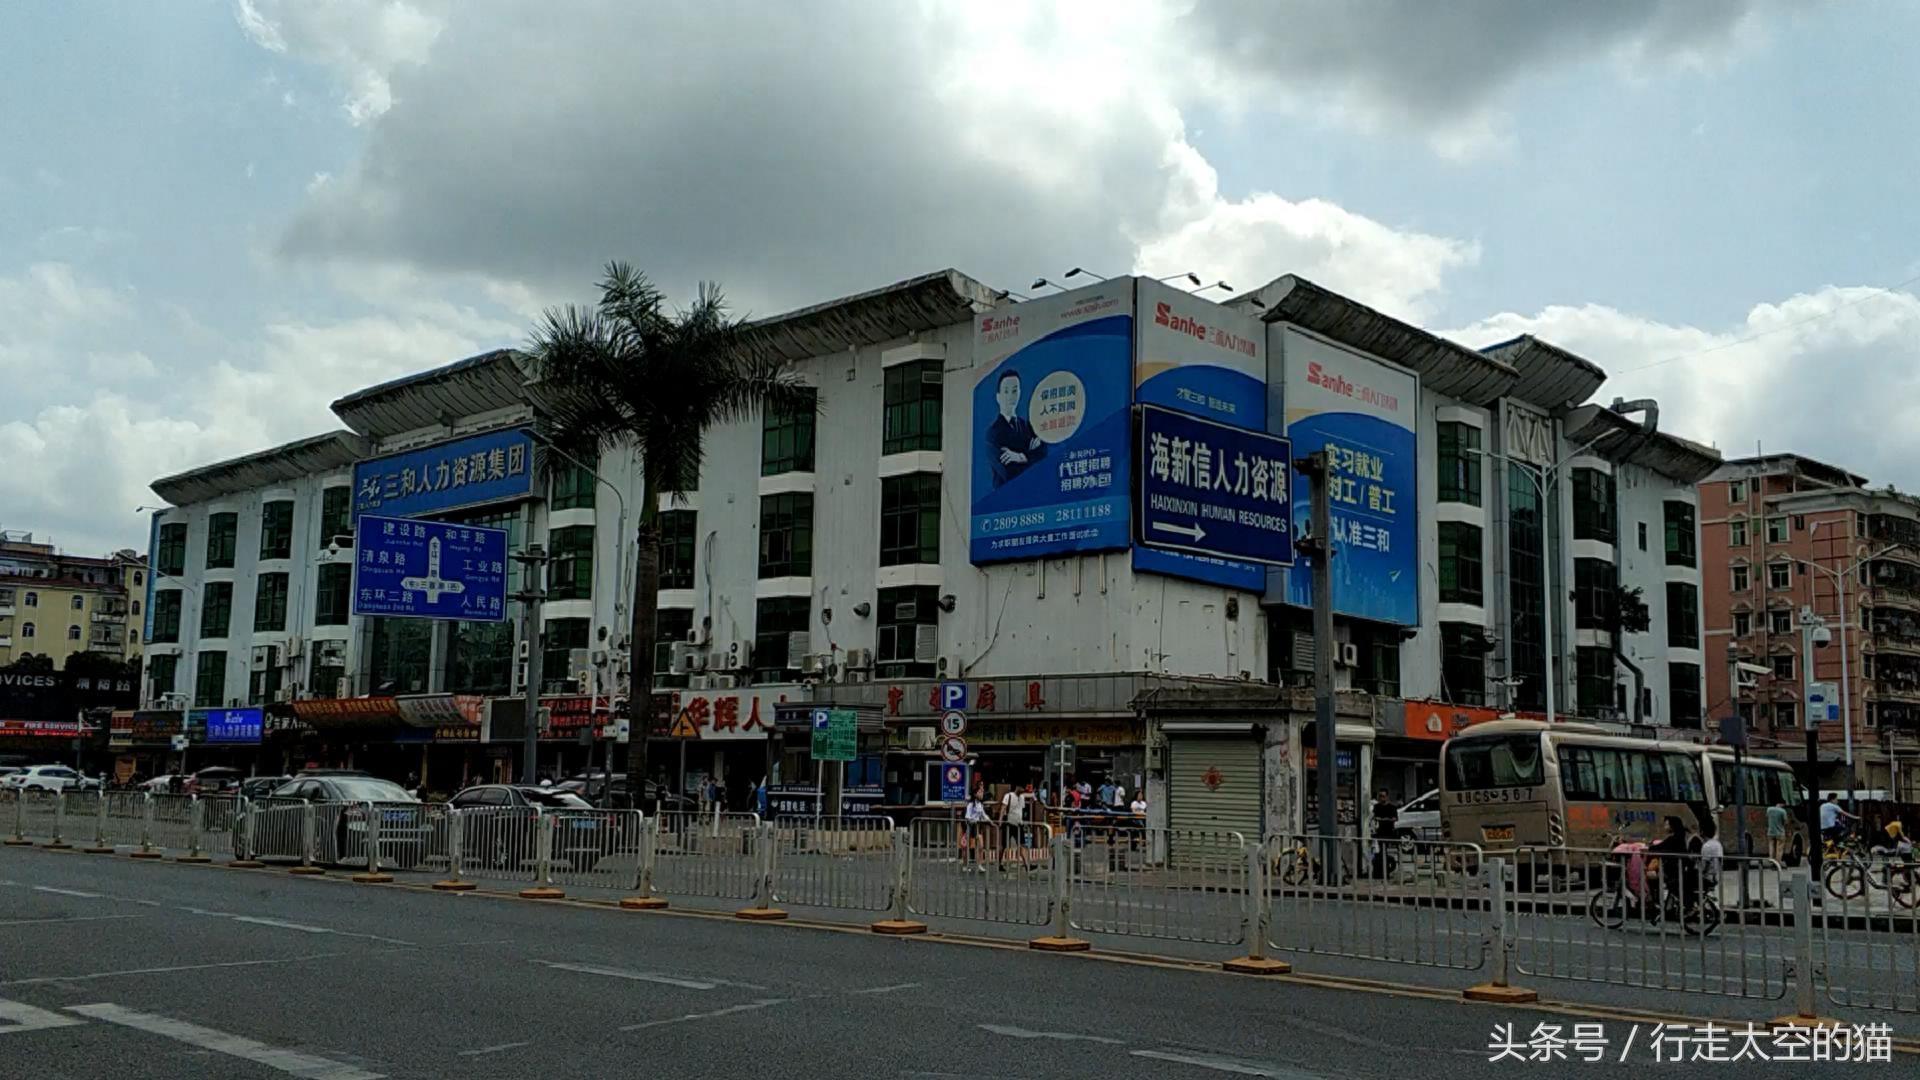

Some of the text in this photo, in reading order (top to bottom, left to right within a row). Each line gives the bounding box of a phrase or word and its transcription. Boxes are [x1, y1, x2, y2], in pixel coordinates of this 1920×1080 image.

[981, 315, 1021, 333] Sanhe
[1155, 301, 1206, 340] Sanhe
[1307, 361, 1353, 397] Sanhe
[383, 442, 526, 498] 三和人力资源集团
[1059, 456, 1111, 478] 代理招聘
[1150, 431, 1288, 505] 海新信人力资源
[1325, 442, 1384, 482] 实习就业
[1060, 472, 1112, 492] 招聘外包
[992, 503, 1112, 531] 2809 8888 2811 1188
[1201, 503, 1236, 523] HUMAN
[1238, 510, 1287, 533] RESOURCES
[383, 521, 426, 538] 建设路
[444, 528, 486, 544] 和平路
[361, 549, 406, 565] 清泉路
[462, 559, 503, 574] 工业路
[360, 588, 414, 604] 东环二路
[460, 595, 501, 610] 人民路
[0, 673, 56, 687] VICES
[945, 685, 963, 708] P
[815, 711, 828, 728] P
[947, 718, 960, 729] 15
